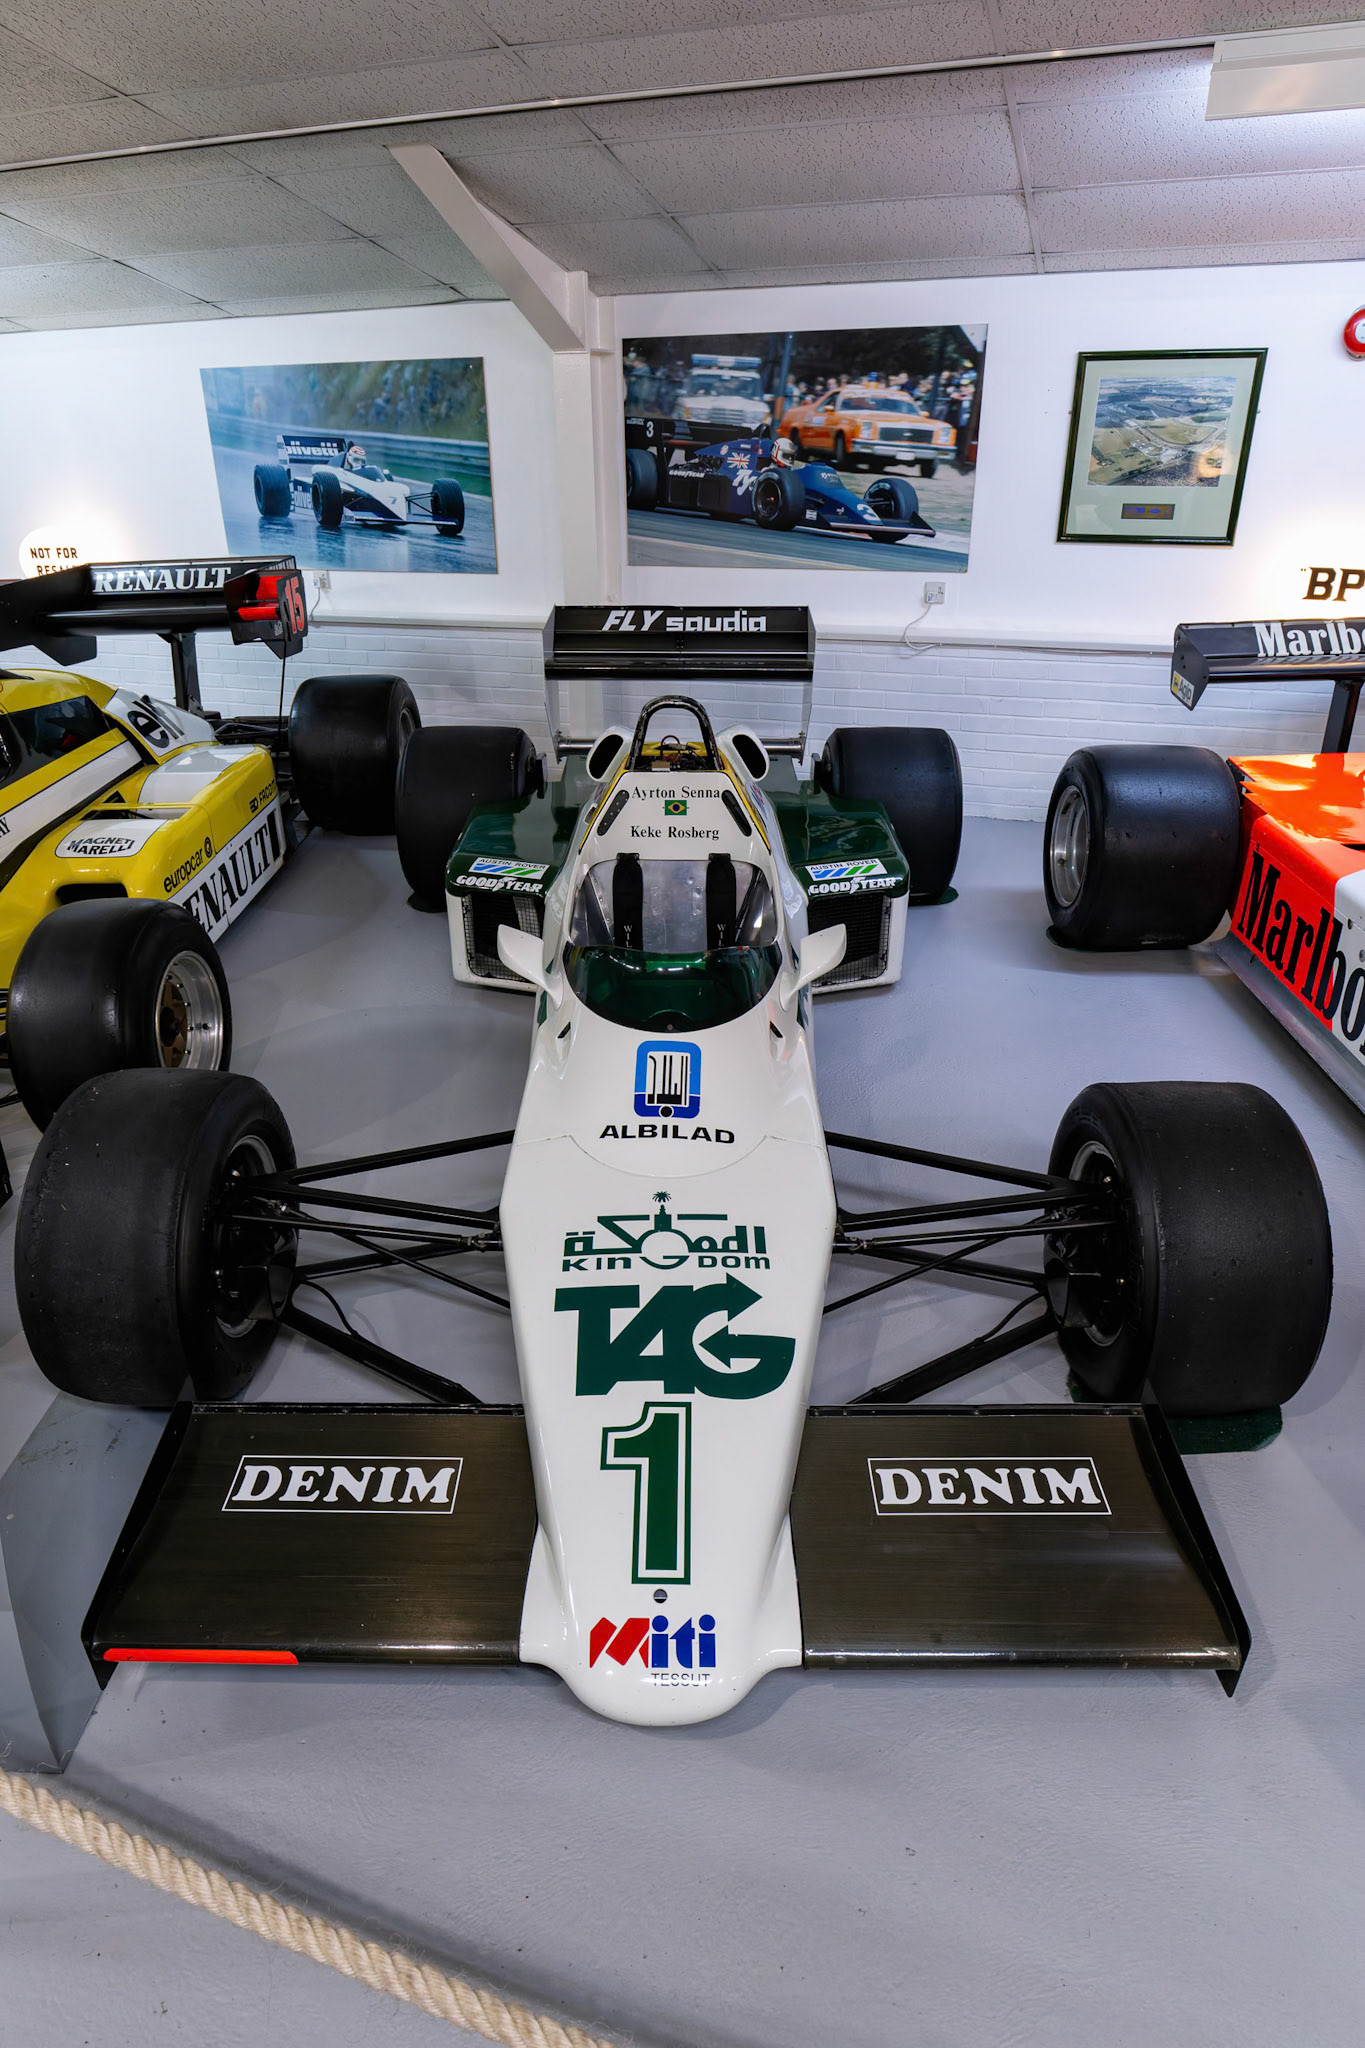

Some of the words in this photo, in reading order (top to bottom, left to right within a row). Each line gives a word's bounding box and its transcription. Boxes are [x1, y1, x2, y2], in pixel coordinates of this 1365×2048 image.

[646, 421, 654, 438] 3
[857, 503, 880, 521] 3
[30, 547, 50, 559] NOT
[56, 547, 78, 559] FOR
[92, 566, 232, 593] RENAULT
[285, 575, 305, 635] 15
[601, 610, 664, 632] FLY
[665, 610, 767, 632] saudia
[1253, 620, 1365, 658] Marlb
[1179, 678, 1192, 703] Agip
[631, 786, 676, 801] Ayrton
[681, 786, 720, 799] Senna
[69, 837, 135, 848] MAGNETI
[631, 825, 662, 838] Keke
[668, 825, 720, 841] Rosberg
[67, 843, 134, 855] MARELLI
[163, 847, 204, 893] europcar
[479, 858, 512, 867] AUSTIN
[810, 862, 843, 871] AUSTIN
[846, 859, 878, 867] ROVER
[456, 875, 543, 892] GOODYEAR
[808, 877, 897, 894] GOODYEAR
[1237, 850, 1365, 1055] Marlbo
[599, 1124, 735, 1144] ALBILAD
[554, 1272, 796, 1400] TAG
[231, 1465, 456, 1504] DENIM
[600, 1401, 692, 1585] 1
[875, 1467, 1102, 1505] DENIM
[589, 1613, 716, 1669] Miti
